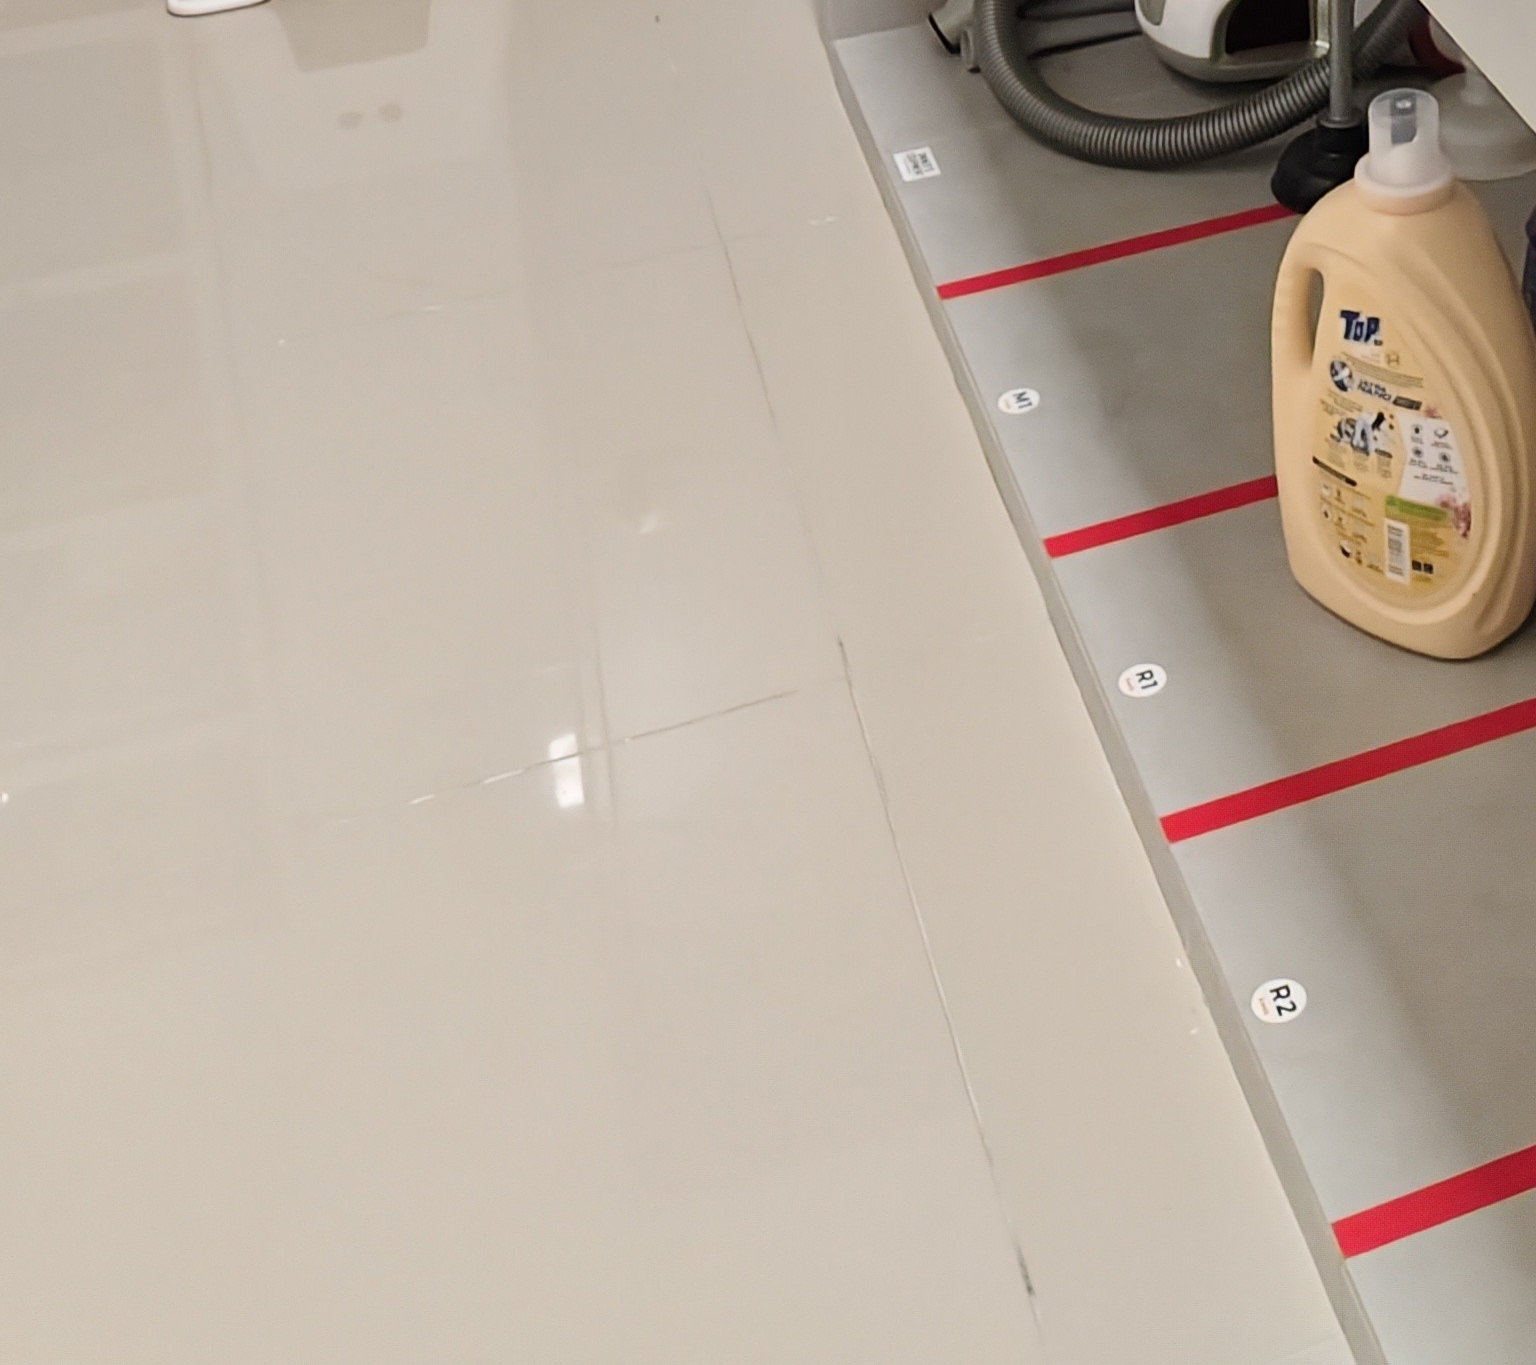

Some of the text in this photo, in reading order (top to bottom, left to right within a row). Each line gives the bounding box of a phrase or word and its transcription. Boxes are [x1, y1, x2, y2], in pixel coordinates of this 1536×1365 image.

[1012, 390, 1033, 409] M1
[1135, 669, 1158, 689] R1
[1269, 984, 1297, 1017] R2
